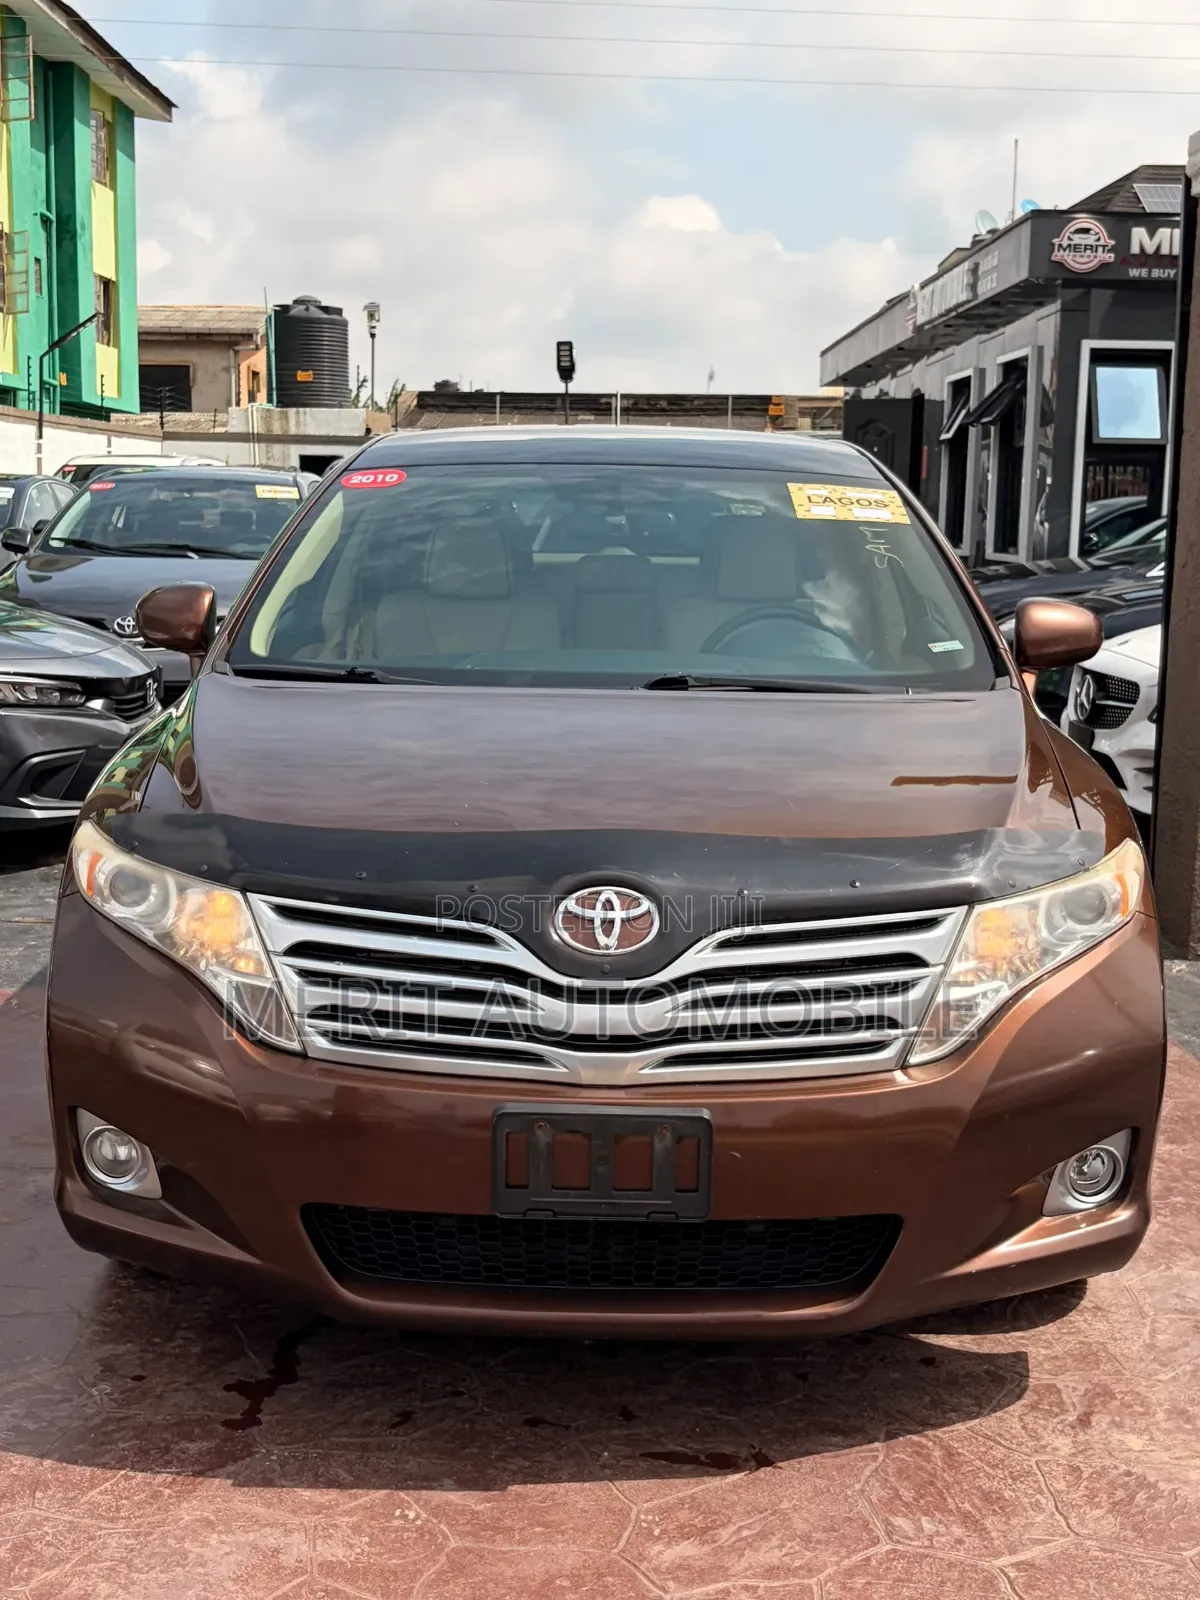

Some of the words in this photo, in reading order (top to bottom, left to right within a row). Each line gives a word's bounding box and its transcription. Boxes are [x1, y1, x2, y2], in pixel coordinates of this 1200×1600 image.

[1057, 243, 1110, 253] MERIT
[1128, 268, 1149, 278] WE
[1151, 268, 1177, 278] BUY
[349, 474, 399, 484] 2010
[807, 496, 890, 508] LAGOS
